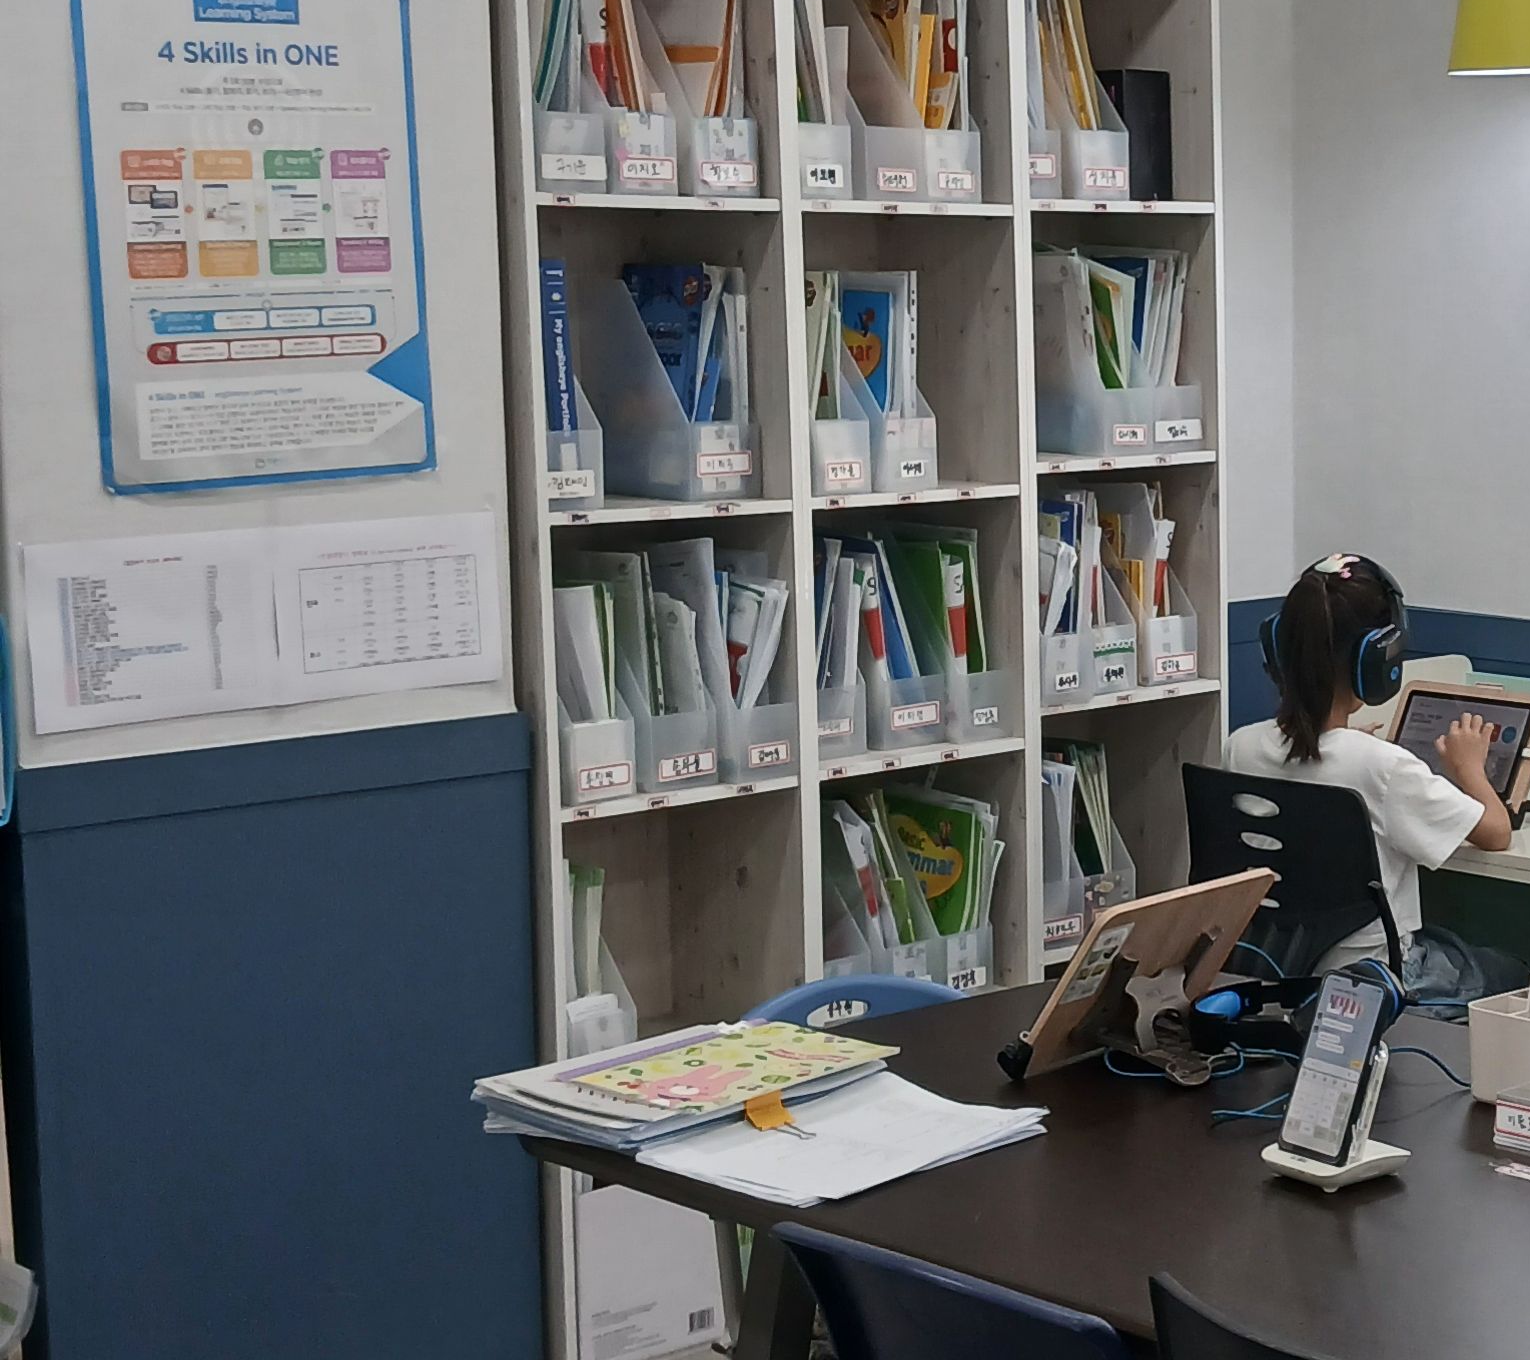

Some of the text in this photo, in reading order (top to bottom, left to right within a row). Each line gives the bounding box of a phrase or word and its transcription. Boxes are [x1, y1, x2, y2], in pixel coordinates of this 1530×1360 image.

[199, 8, 295, 22] Learning System
[157, 40, 340, 67] 4 Skills in ONE
[554, 319, 564, 334] My
